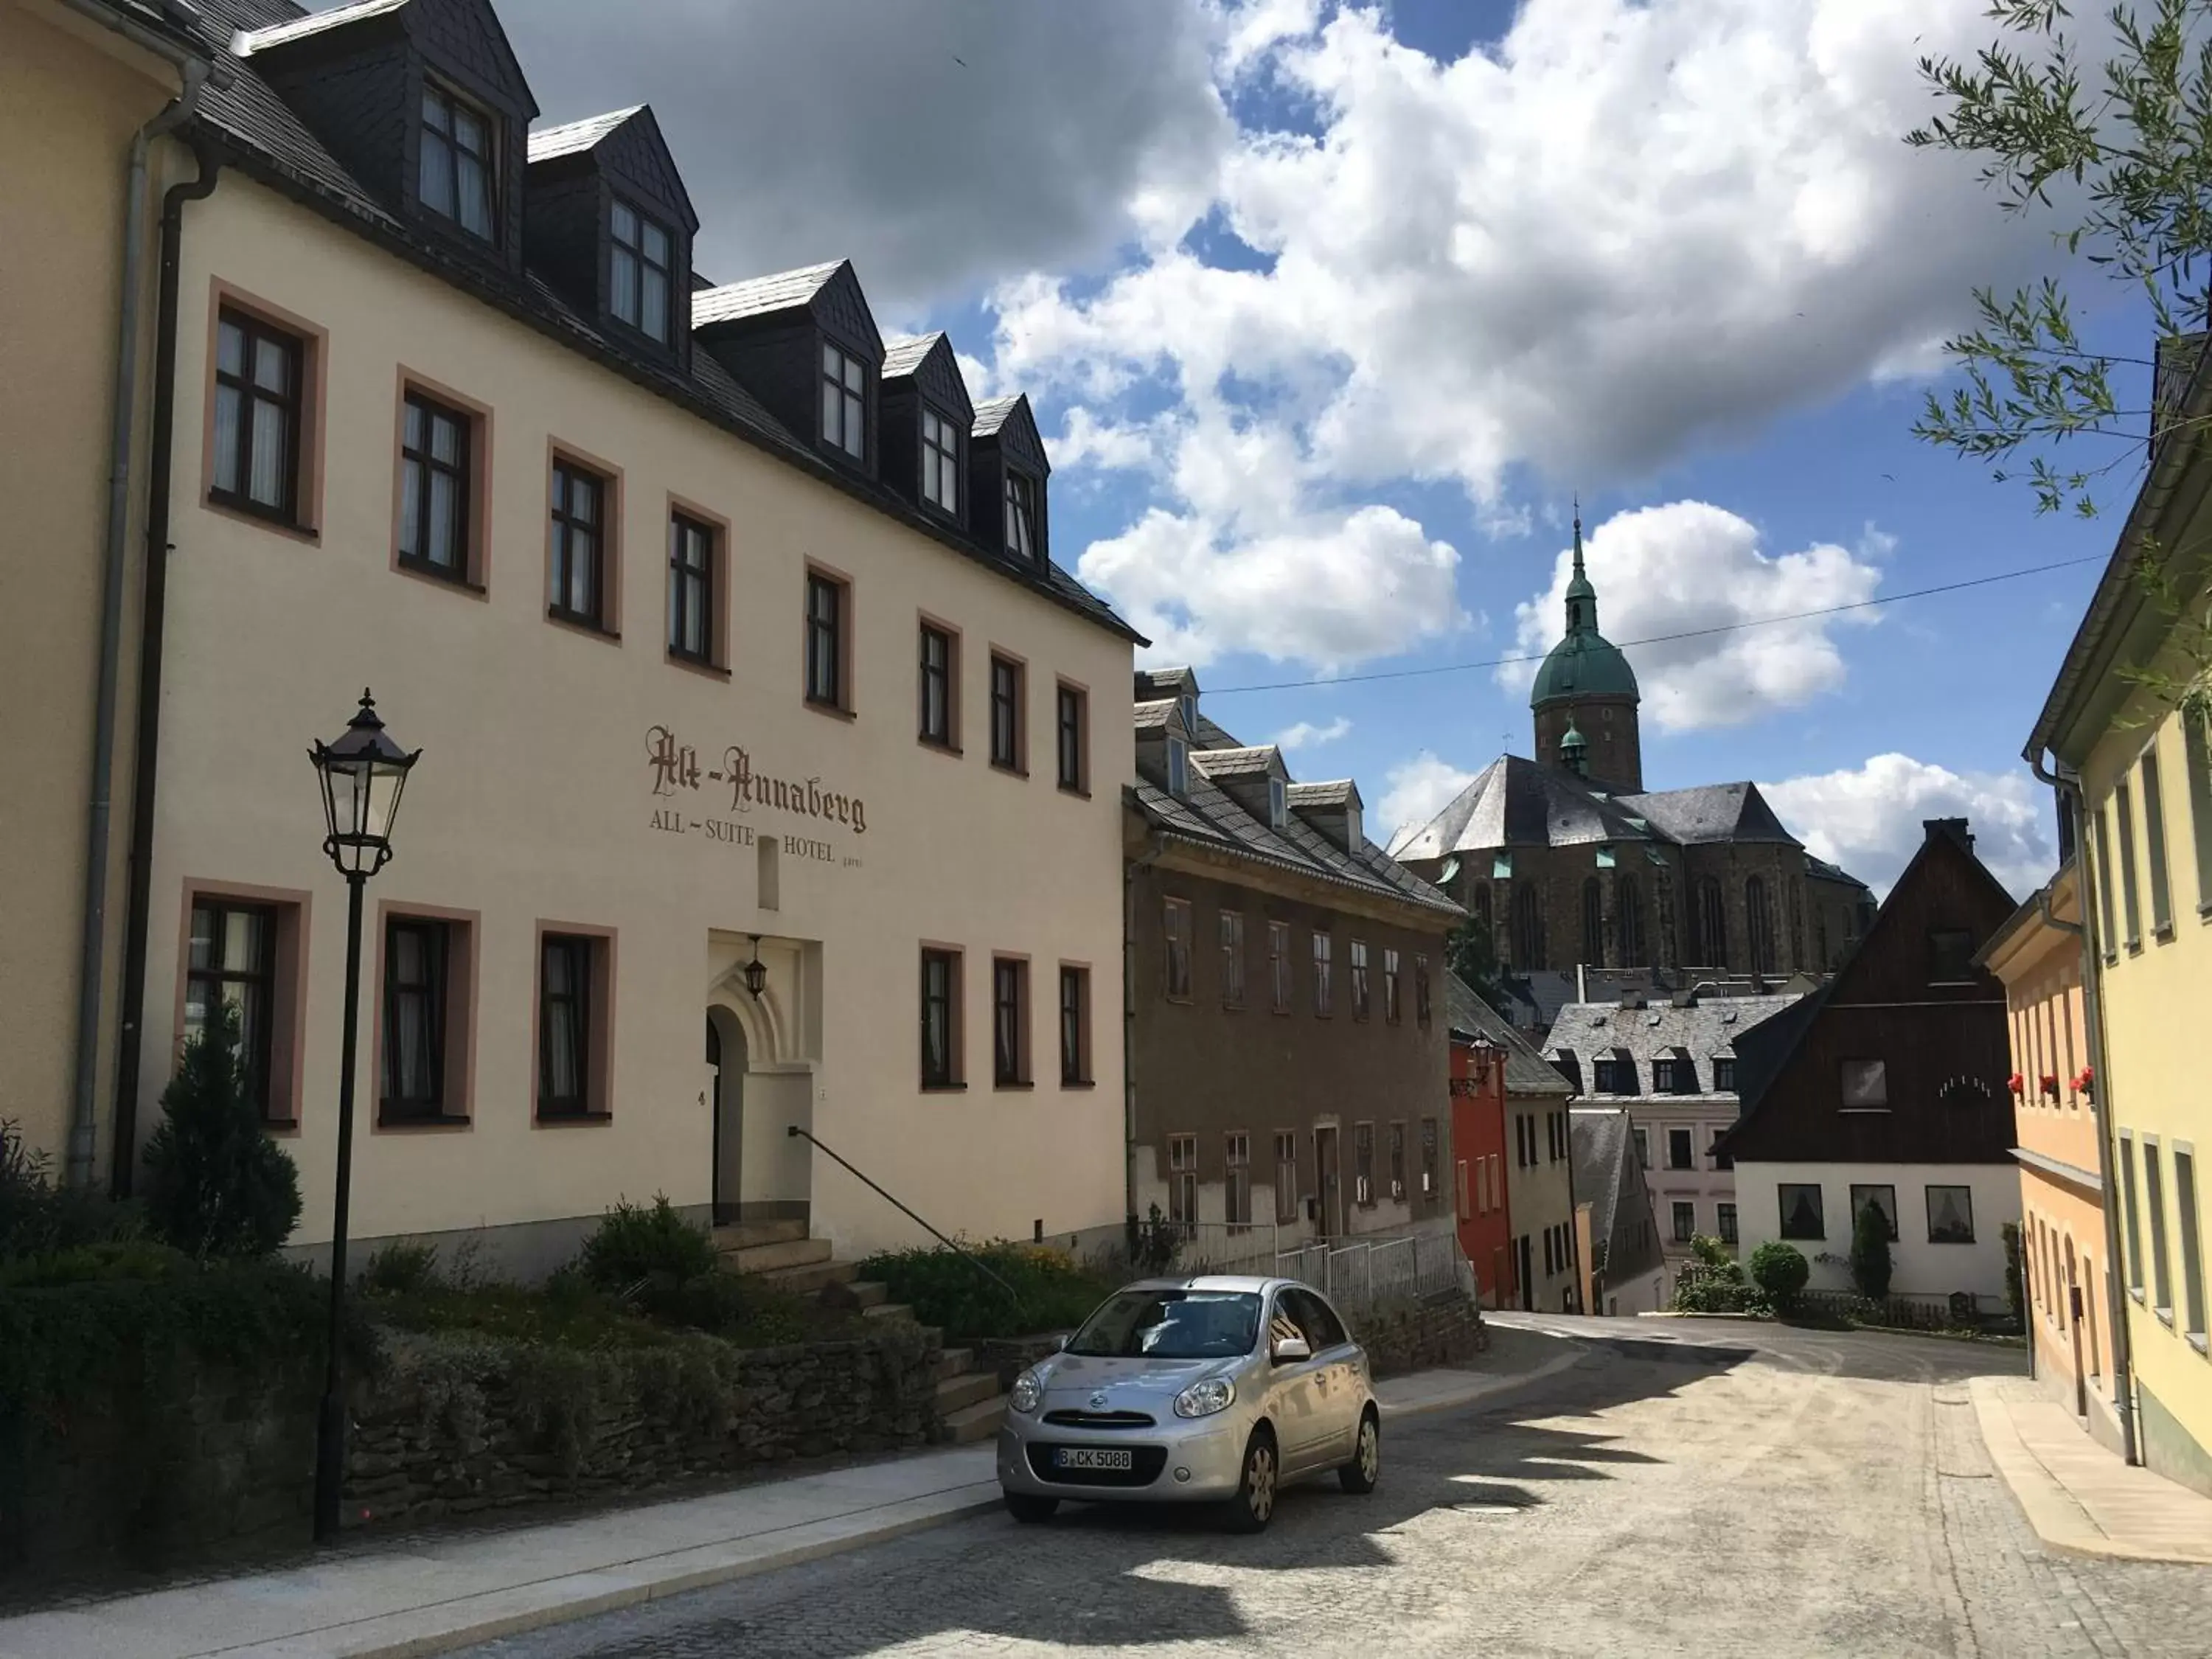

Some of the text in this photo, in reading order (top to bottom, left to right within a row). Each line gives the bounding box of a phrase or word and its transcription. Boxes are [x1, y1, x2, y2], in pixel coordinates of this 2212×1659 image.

[784, 835, 835, 862] HOTEL
[1077, 1450, 1093, 1466] CK
[1096, 1451, 1130, 1468] 5088
